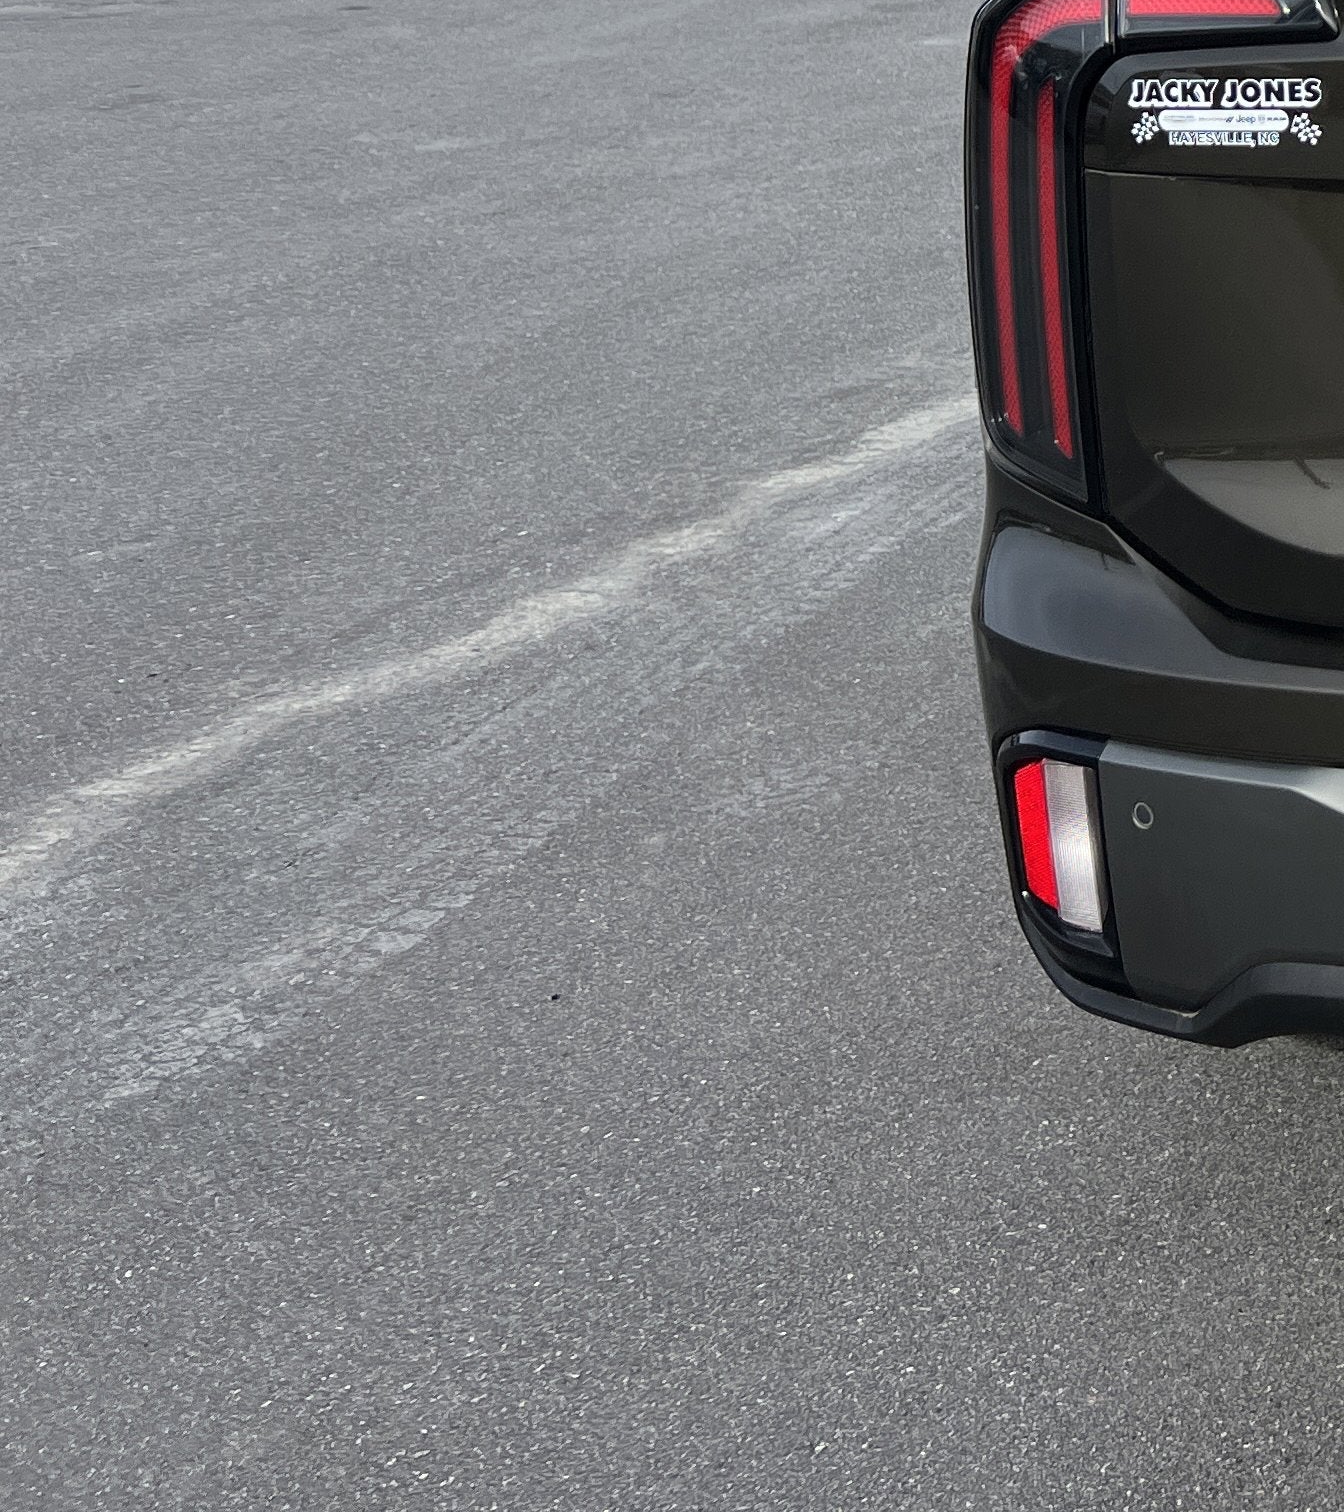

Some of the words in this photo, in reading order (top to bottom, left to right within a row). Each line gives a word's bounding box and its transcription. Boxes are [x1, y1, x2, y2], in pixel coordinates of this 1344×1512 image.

[1128, 79, 1219, 107] JACKY
[1221, 78, 1322, 107] JONES
[1235, 114, 1257, 124] Jeep
[1168, 131, 1257, 147] HAYESVILLE,
[1257, 131, 1280, 146] NC
